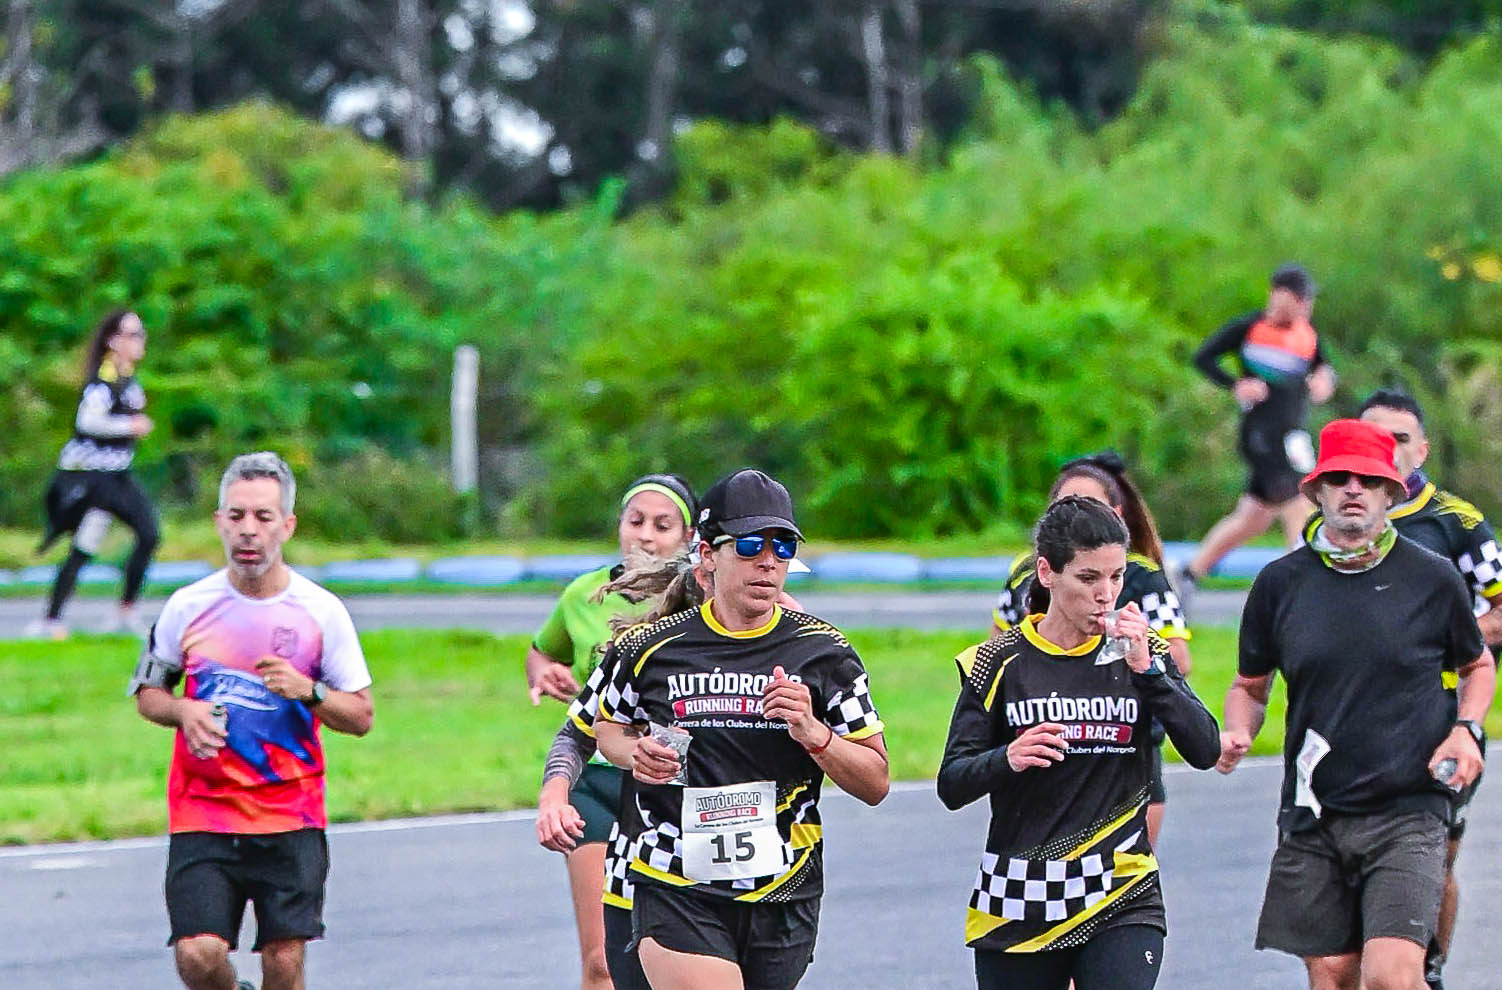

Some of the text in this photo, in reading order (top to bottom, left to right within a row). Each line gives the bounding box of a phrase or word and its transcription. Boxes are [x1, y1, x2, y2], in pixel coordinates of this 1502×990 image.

[667, 667, 802, 700] AUTÓDRO
[685, 698, 764, 715] RUNNING RA
[1006, 692, 1138, 727] AUTÓDROMO
[701, 719, 711, 728] de
[712, 719, 724, 728] los
[726, 719, 753, 729] Clubes
[755, 720, 767, 729] del
[1085, 725, 1120, 742] RACE
[1093, 745, 1105, 754] del
[696, 791, 761, 812] AUTÓDROMO
[710, 831, 755, 864] 15
